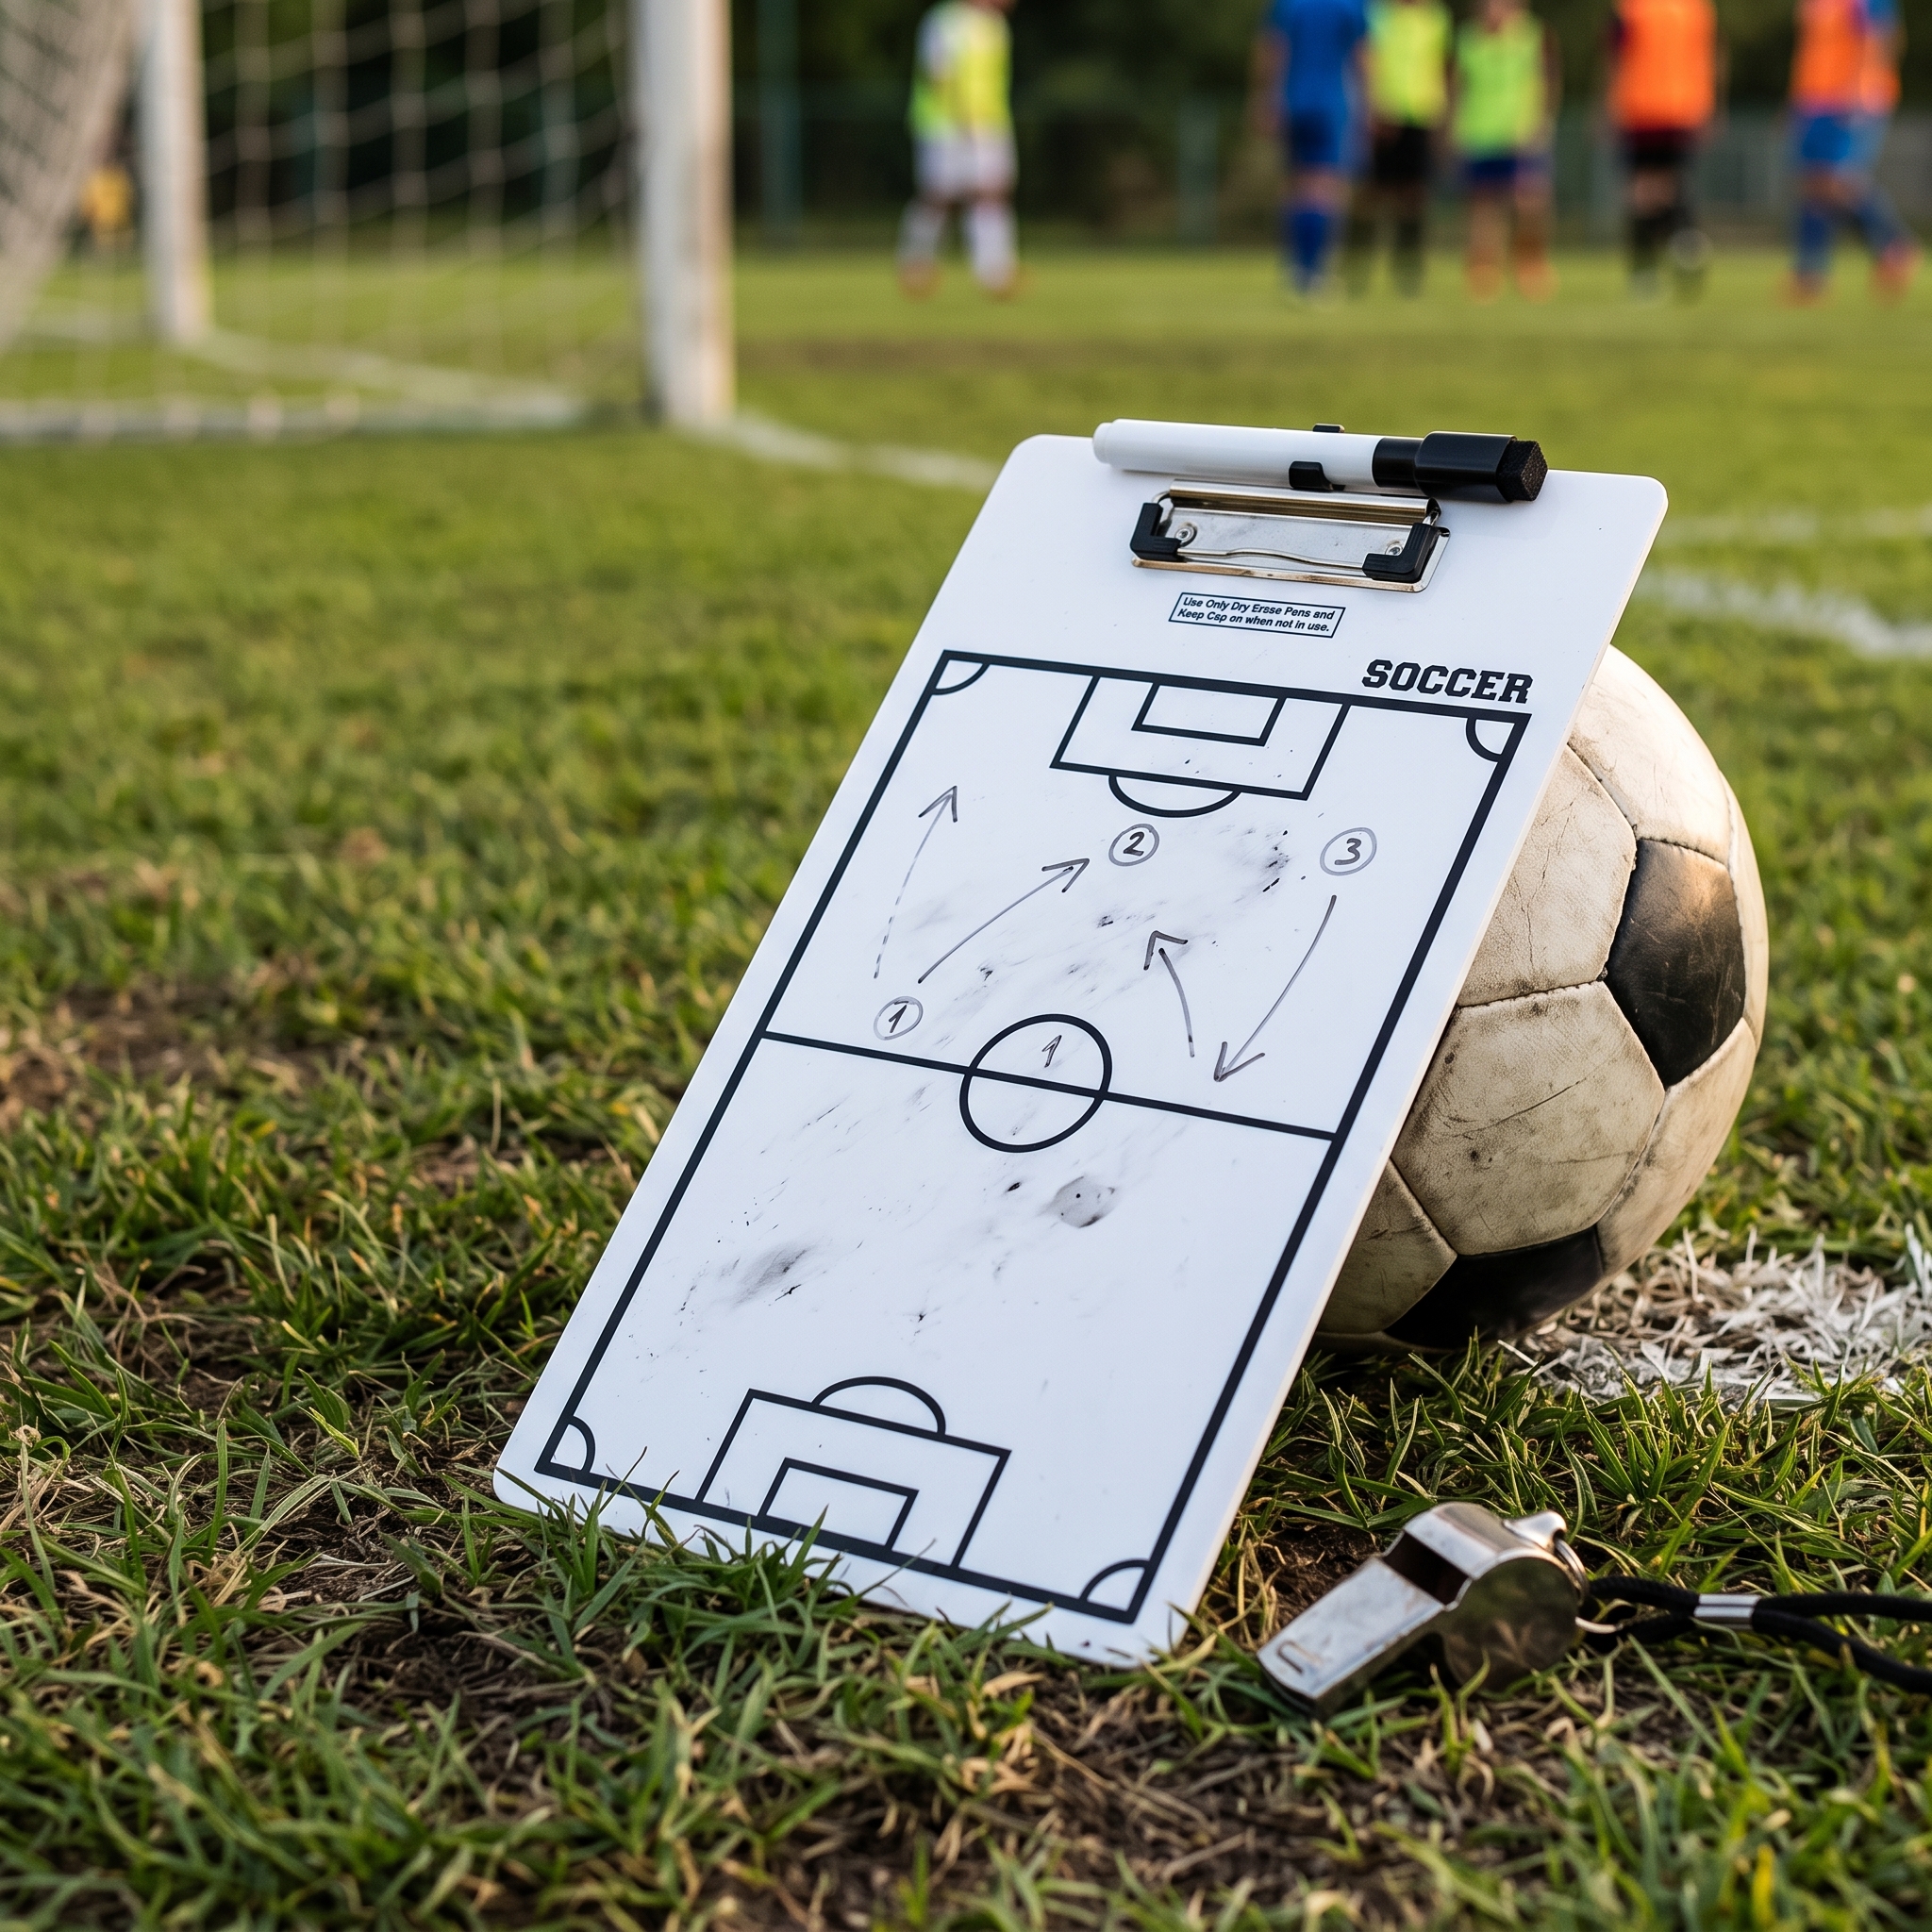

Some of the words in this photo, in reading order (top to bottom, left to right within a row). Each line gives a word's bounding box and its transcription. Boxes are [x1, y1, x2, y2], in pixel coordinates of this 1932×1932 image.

[1177, 608, 1205, 621] Keep
[1229, 615, 1243, 624] on
[1245, 615, 1274, 626] when
[1274, 620, 1293, 629] not
[1294, 621, 1306, 630] in
[1307, 623, 1330, 632] use.
[1183, 596, 1204, 608] Use
[1206, 599, 1230, 611] Only
[1230, 602, 1251, 613] Dry
[1283, 607, 1311, 618] Pens
[1361, 658, 1534, 705] SOCCER
[1123, 830, 1145, 858] 2
[1334, 838, 1362, 866] 3
